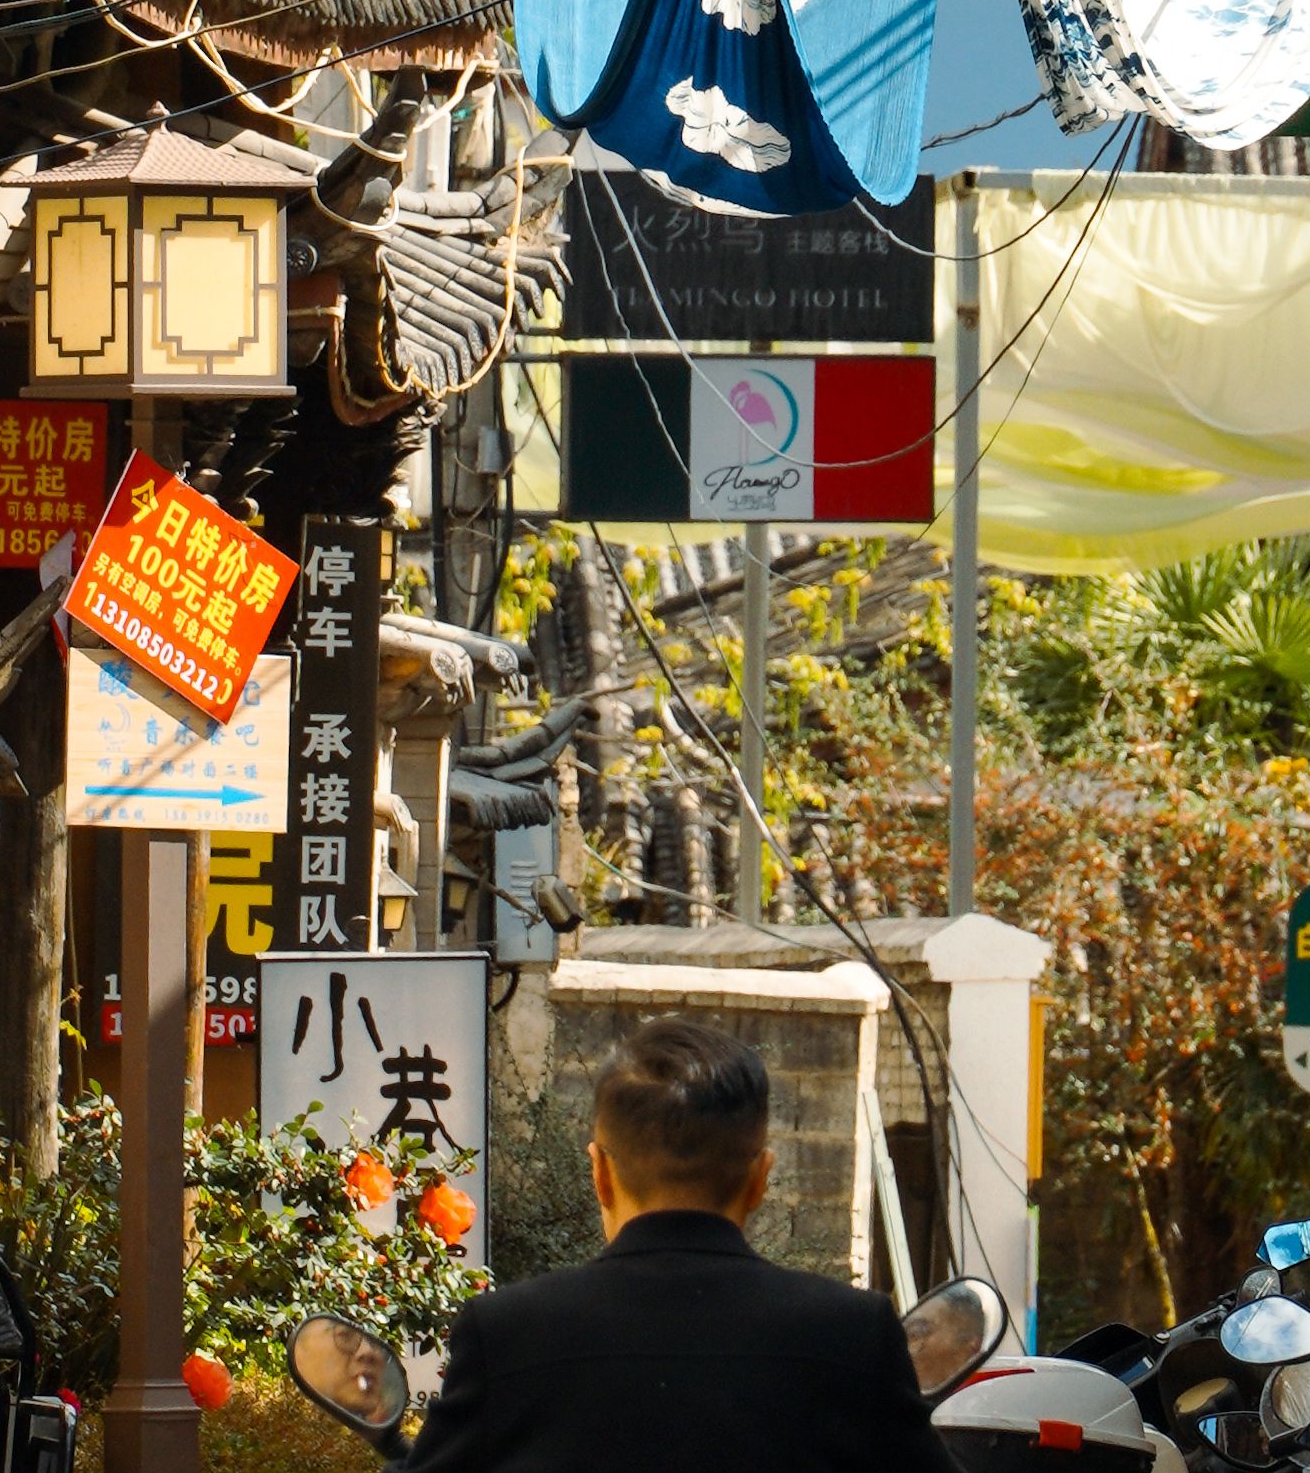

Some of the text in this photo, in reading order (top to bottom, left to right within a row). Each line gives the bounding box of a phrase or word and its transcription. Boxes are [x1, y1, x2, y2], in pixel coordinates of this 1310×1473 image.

[127, 534, 238, 636] 100元起
[130, 478, 281, 614] 今日特价房
[298, 544, 357, 945] 停车 承接团队
